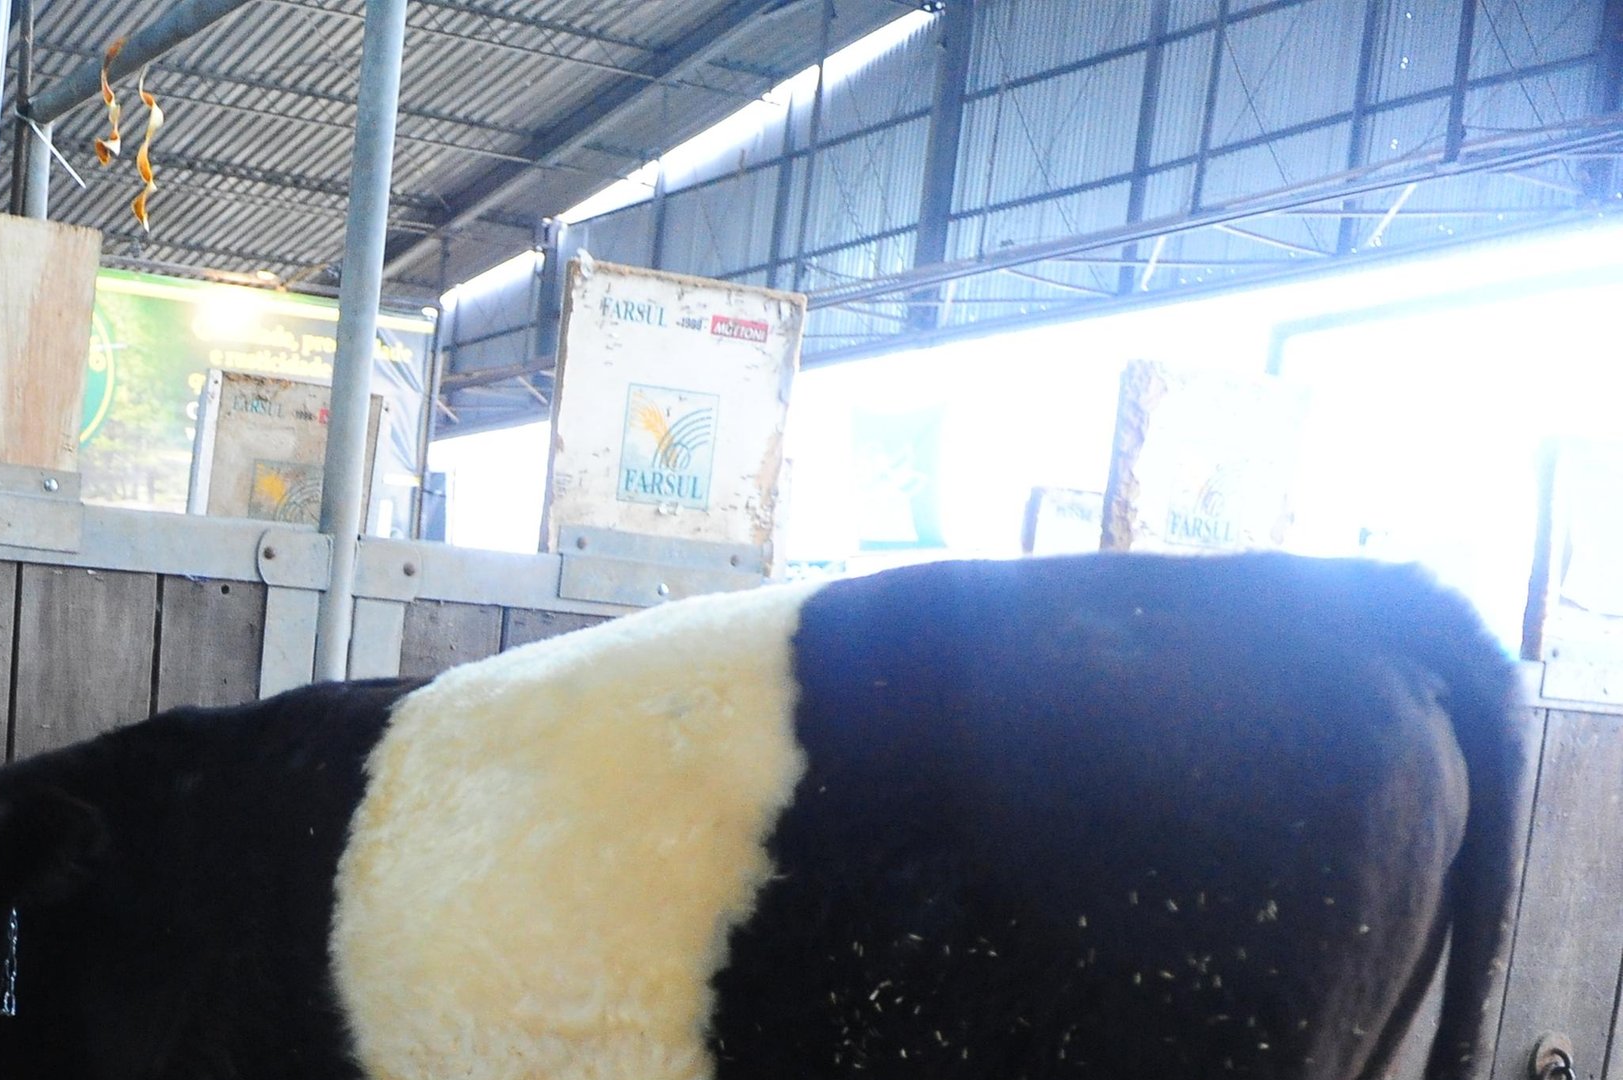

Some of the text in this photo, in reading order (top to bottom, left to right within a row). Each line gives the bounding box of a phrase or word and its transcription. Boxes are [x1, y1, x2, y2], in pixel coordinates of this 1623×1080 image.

[600, 296, 667, 328] FARSUL
[624, 468, 704, 500] FARSUL
[1169, 509, 1235, 543] FARSUL
